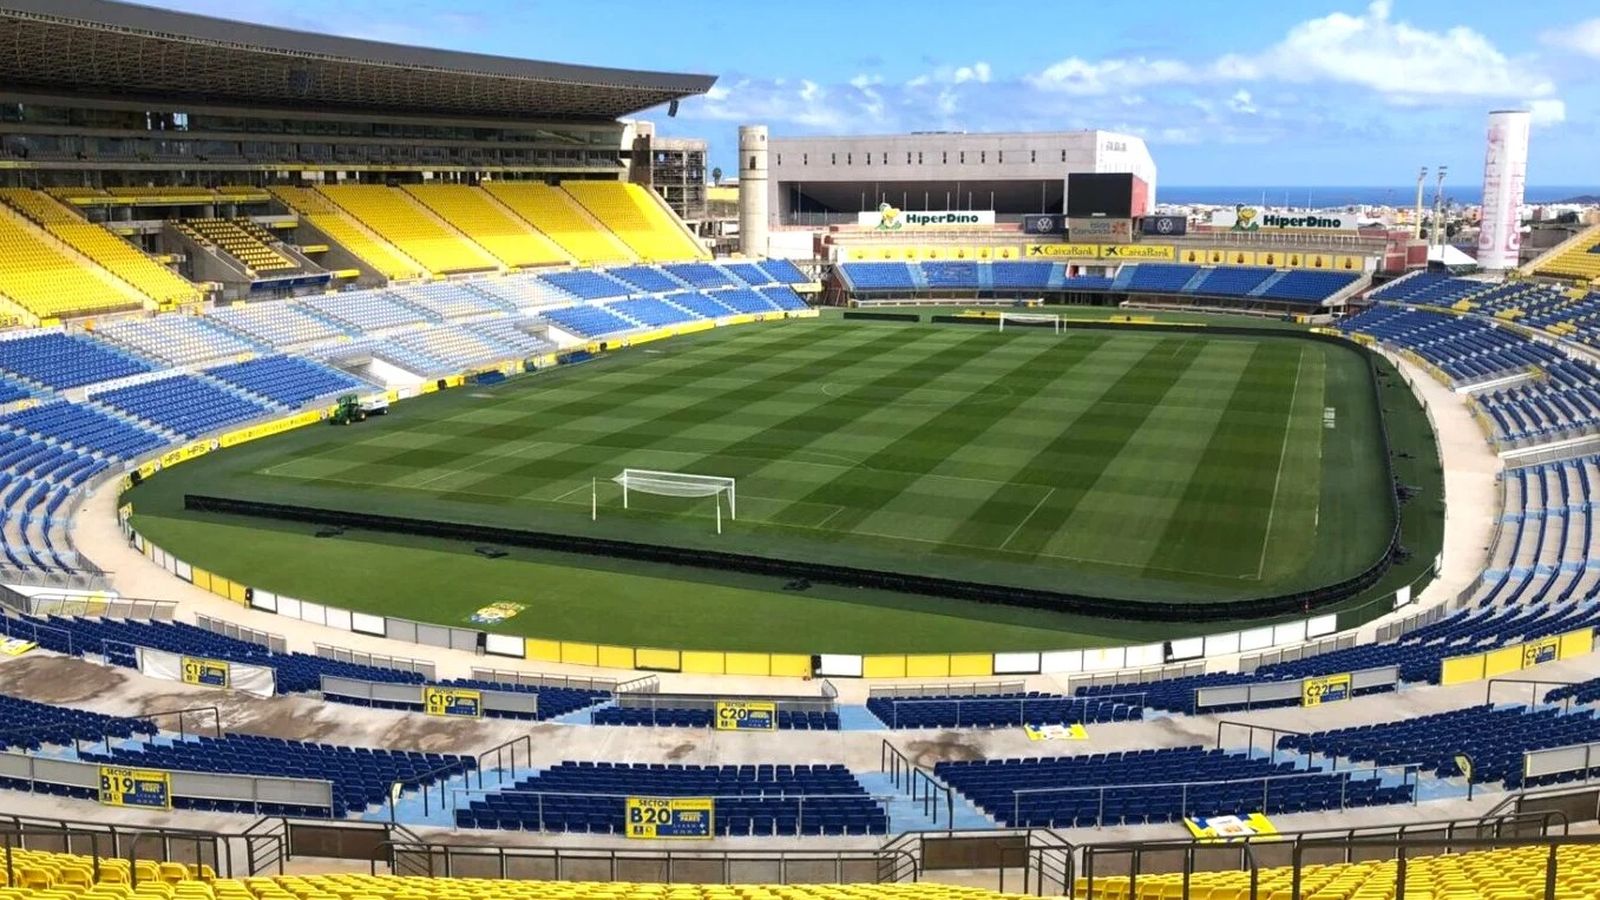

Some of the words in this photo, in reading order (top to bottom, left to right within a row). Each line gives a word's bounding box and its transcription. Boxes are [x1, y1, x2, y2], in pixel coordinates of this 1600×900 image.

[905, 213, 979, 226] HiperDino
[1263, 215, 1341, 228] HiperDino
[1044, 246, 1093, 256] CaixaBank
[1118, 247, 1169, 257] CaixaBank
[185, 663, 206, 676] C18
[1307, 684, 1328, 697] C22
[430, 694, 454, 706] C19
[720, 707, 747, 719] C20
[102, 775, 133, 792] B19
[639, 799, 670, 808] SECTOR
[631, 807, 671, 824] B20
